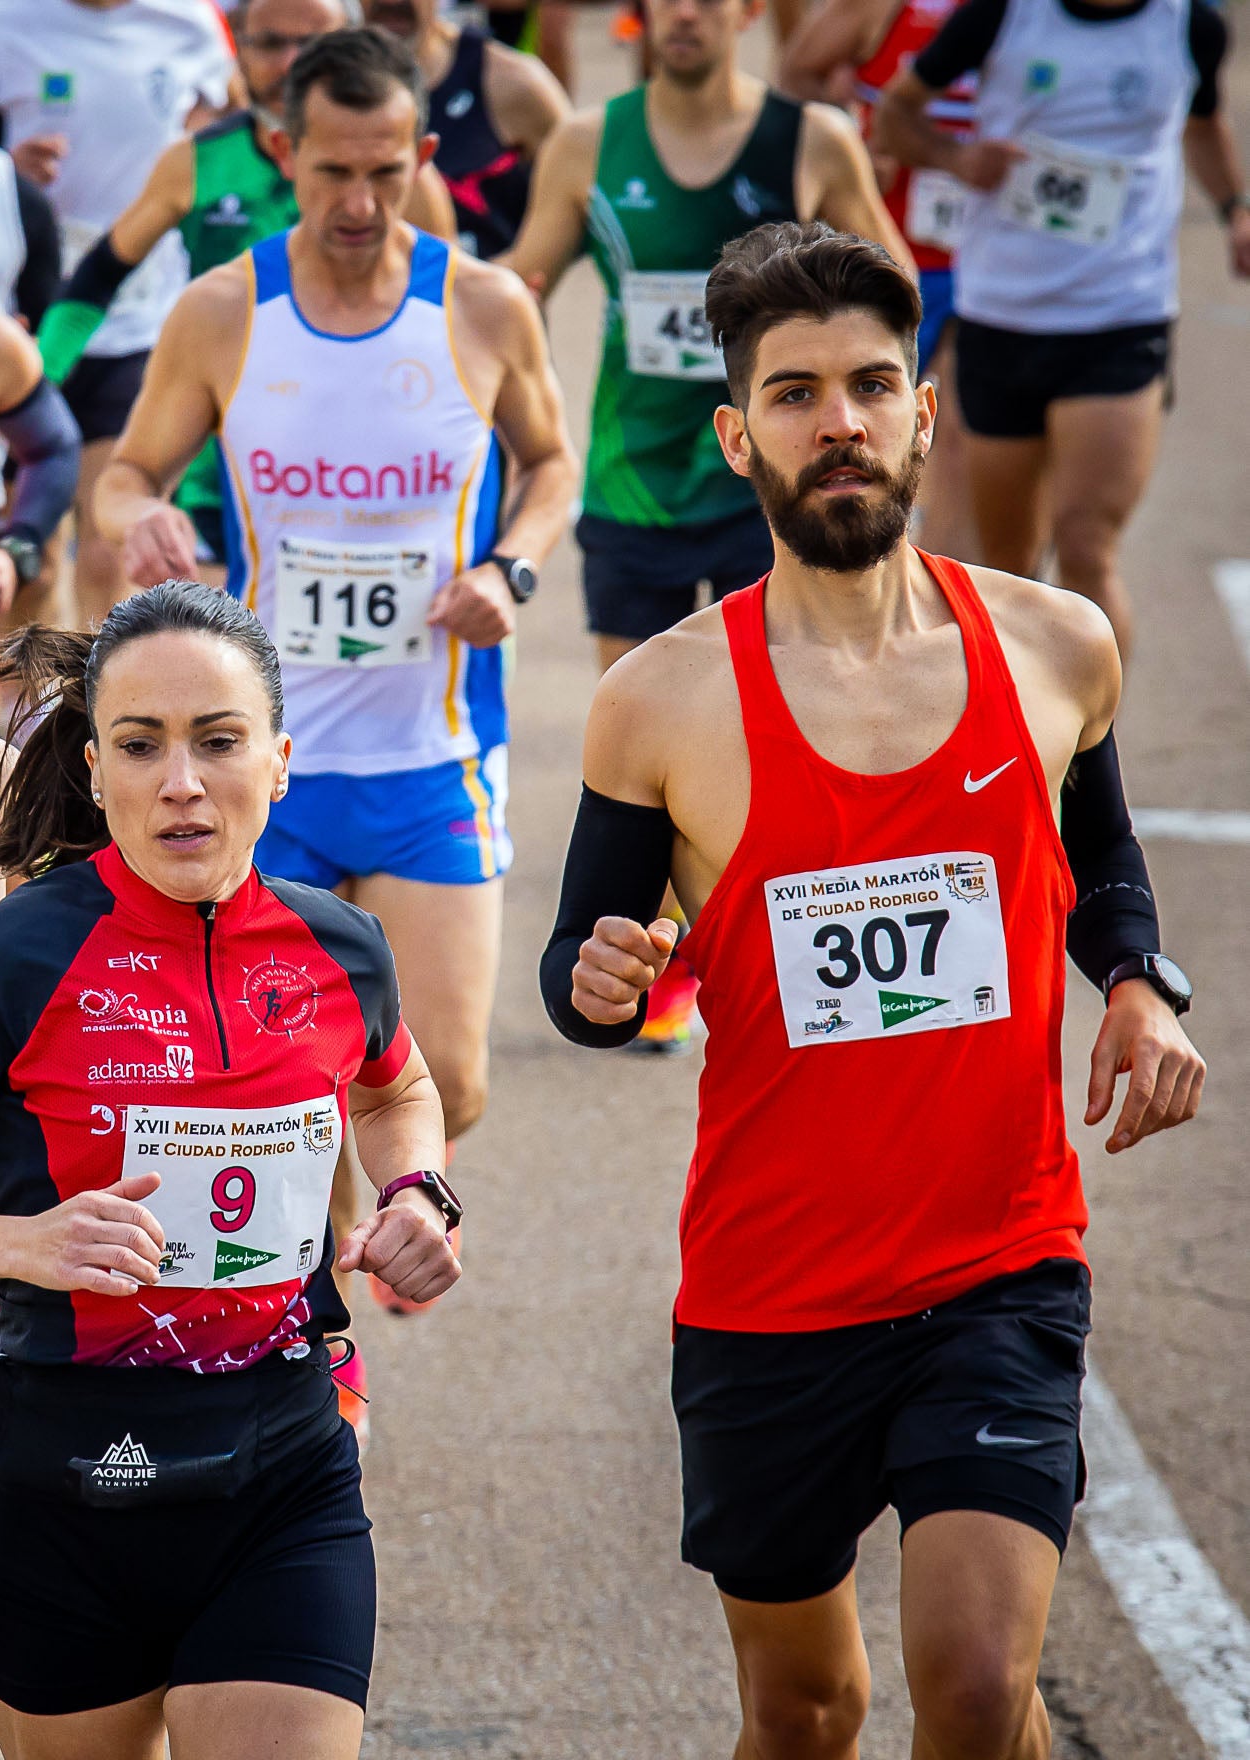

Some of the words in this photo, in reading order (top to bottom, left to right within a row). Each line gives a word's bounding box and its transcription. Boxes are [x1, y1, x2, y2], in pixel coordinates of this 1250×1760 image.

[250, 449, 454, 499] Botanik
[302, 579, 398, 629] 116
[773, 884, 808, 902] XVII
[811, 880, 861, 898] MEDIA
[864, 866, 941, 890] MARATÓN
[960, 875, 985, 888] 2024
[782, 908, 803, 921] DE
[806, 900, 866, 919] CIUDAD
[869, 890, 940, 910] RODRIGO
[812, 908, 951, 990] 307
[107, 951, 159, 973] EKT
[815, 998, 842, 1010] SERGIO
[127, 1003, 189, 1028] tapia
[82, 1021, 145, 1033] maquinaria
[88, 1057, 167, 1080] adamas
[134, 1119, 170, 1134] XVII
[174, 1120, 227, 1136] MEDIA
[231, 1116, 301, 1137] MARATÓN
[314, 1125, 333, 1139] 2024
[137, 1143, 160, 1156] DE
[163, 1142, 226, 1158] CIUDAD
[230, 1140, 296, 1158] RODRIGO
[210, 1165, 257, 1234] 9
[164, 1241, 187, 1252] NDRA
[91, 1467, 158, 1480] AONIJIE
[97, 1480, 149, 1488] RUNNING
